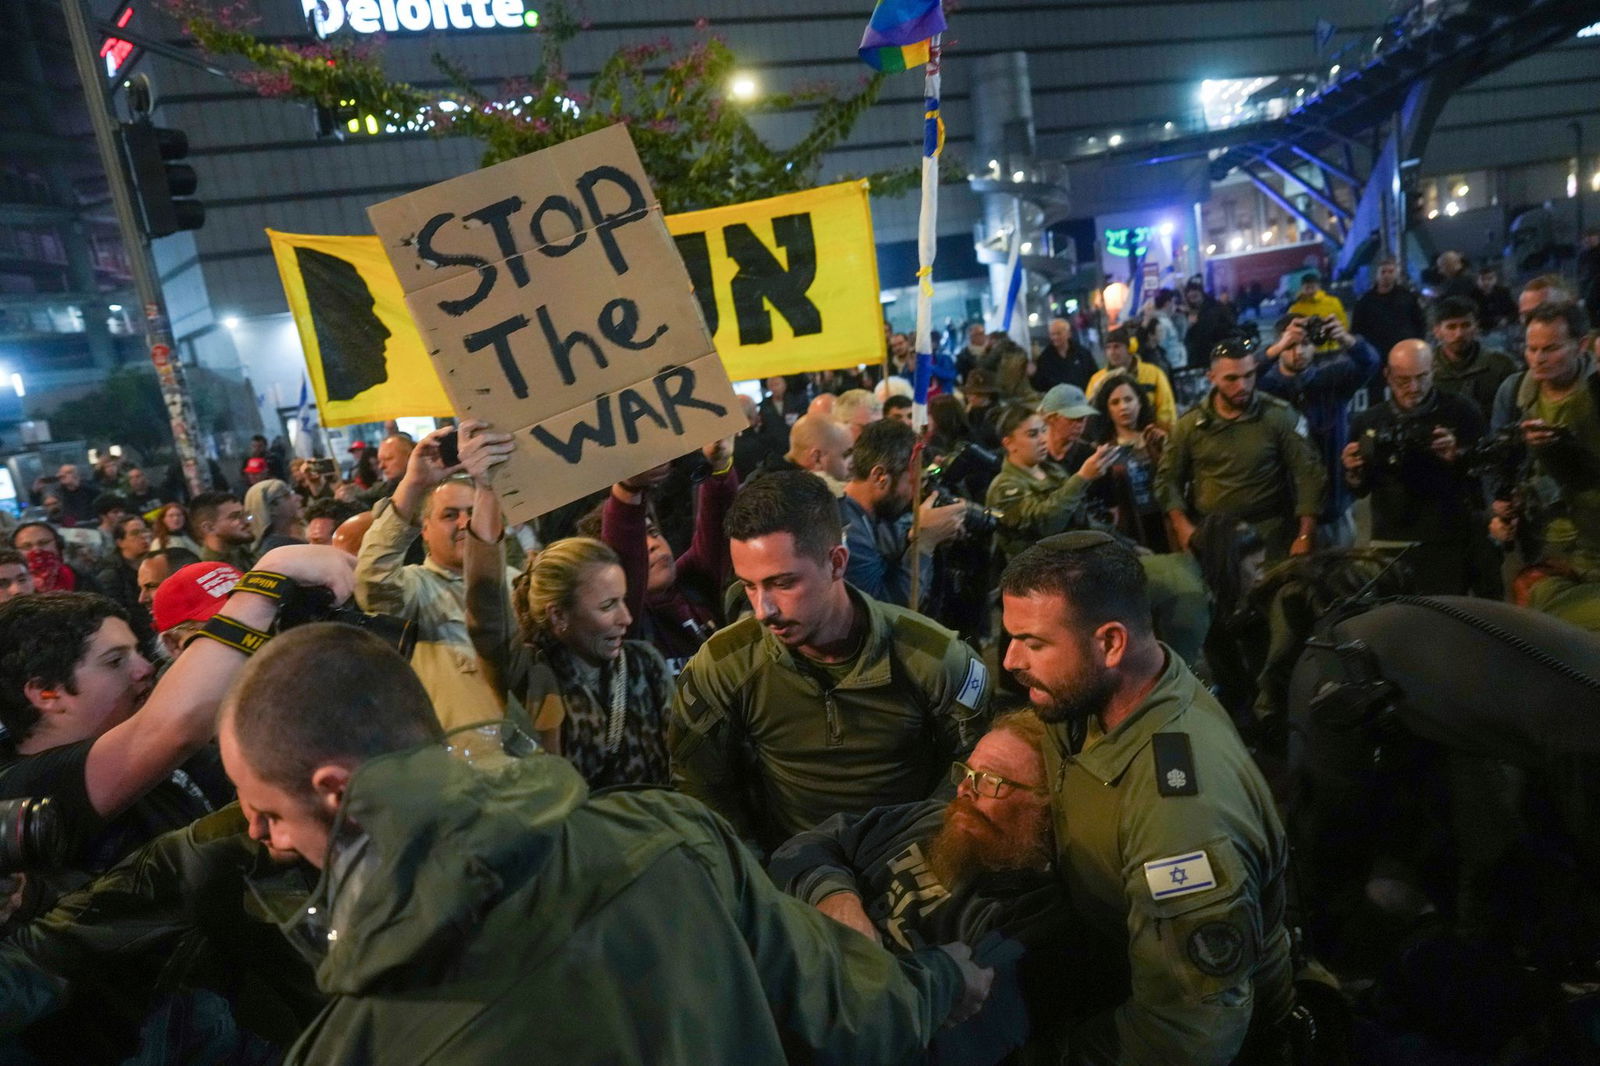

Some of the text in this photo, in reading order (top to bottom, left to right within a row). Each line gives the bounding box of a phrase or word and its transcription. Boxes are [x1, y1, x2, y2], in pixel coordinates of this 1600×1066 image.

[416, 165, 649, 317] STOP
[463, 298, 670, 399] The
[529, 365, 728, 464] WAR
[241, 633, 265, 650] Ni
